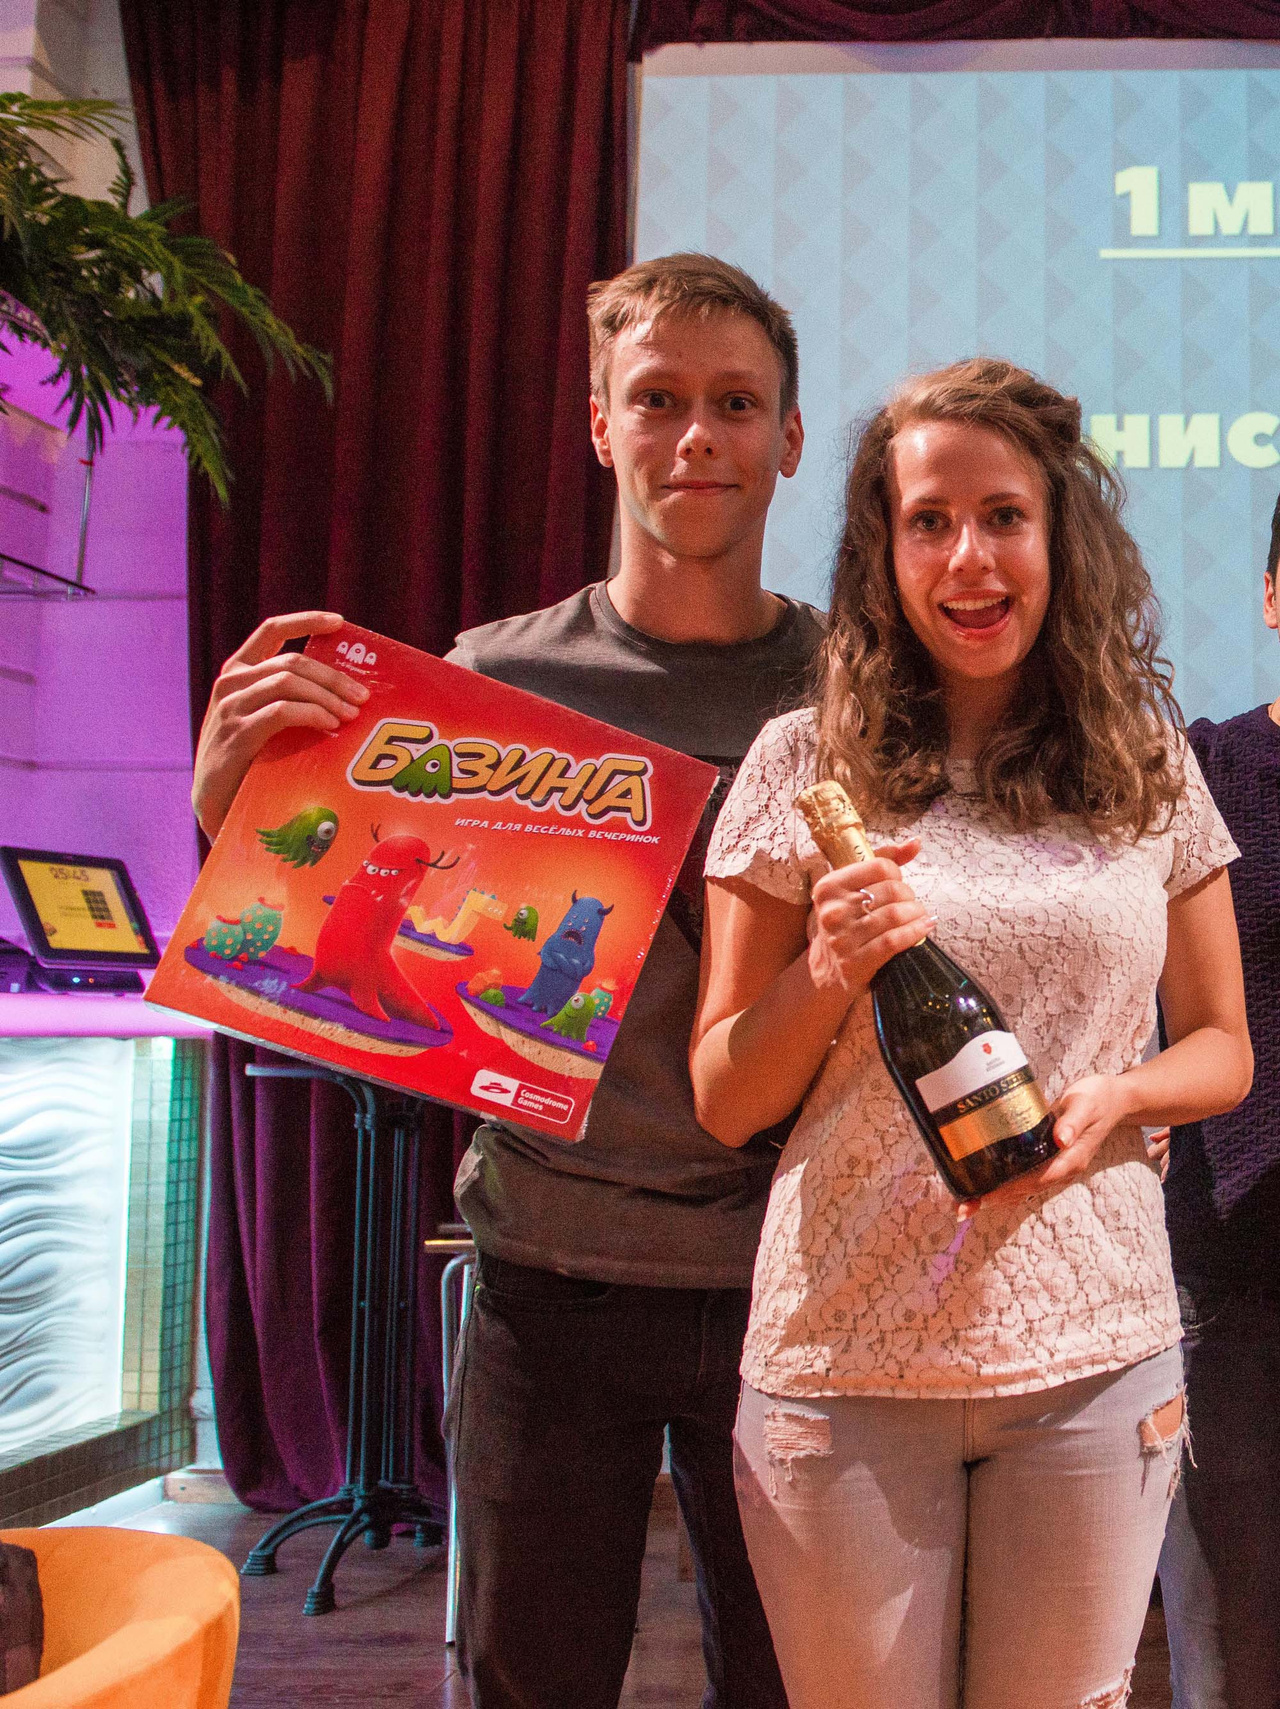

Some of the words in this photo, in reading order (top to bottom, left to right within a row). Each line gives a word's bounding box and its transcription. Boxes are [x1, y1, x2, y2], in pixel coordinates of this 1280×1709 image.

[1114, 165, 1160, 237] 1
[348, 720, 650, 829] БАЗИНГА
[454, 817, 489, 829] ИГРА
[490, 821, 523, 832] ДЛЯ
[523, 824, 586, 838] ВЕСЁЛЫХ
[587, 830, 661, 845] ВЕЧЕРИНОК
[517, 1097, 544, 1111] Games
[520, 1089, 569, 1111] Cosmodrome
